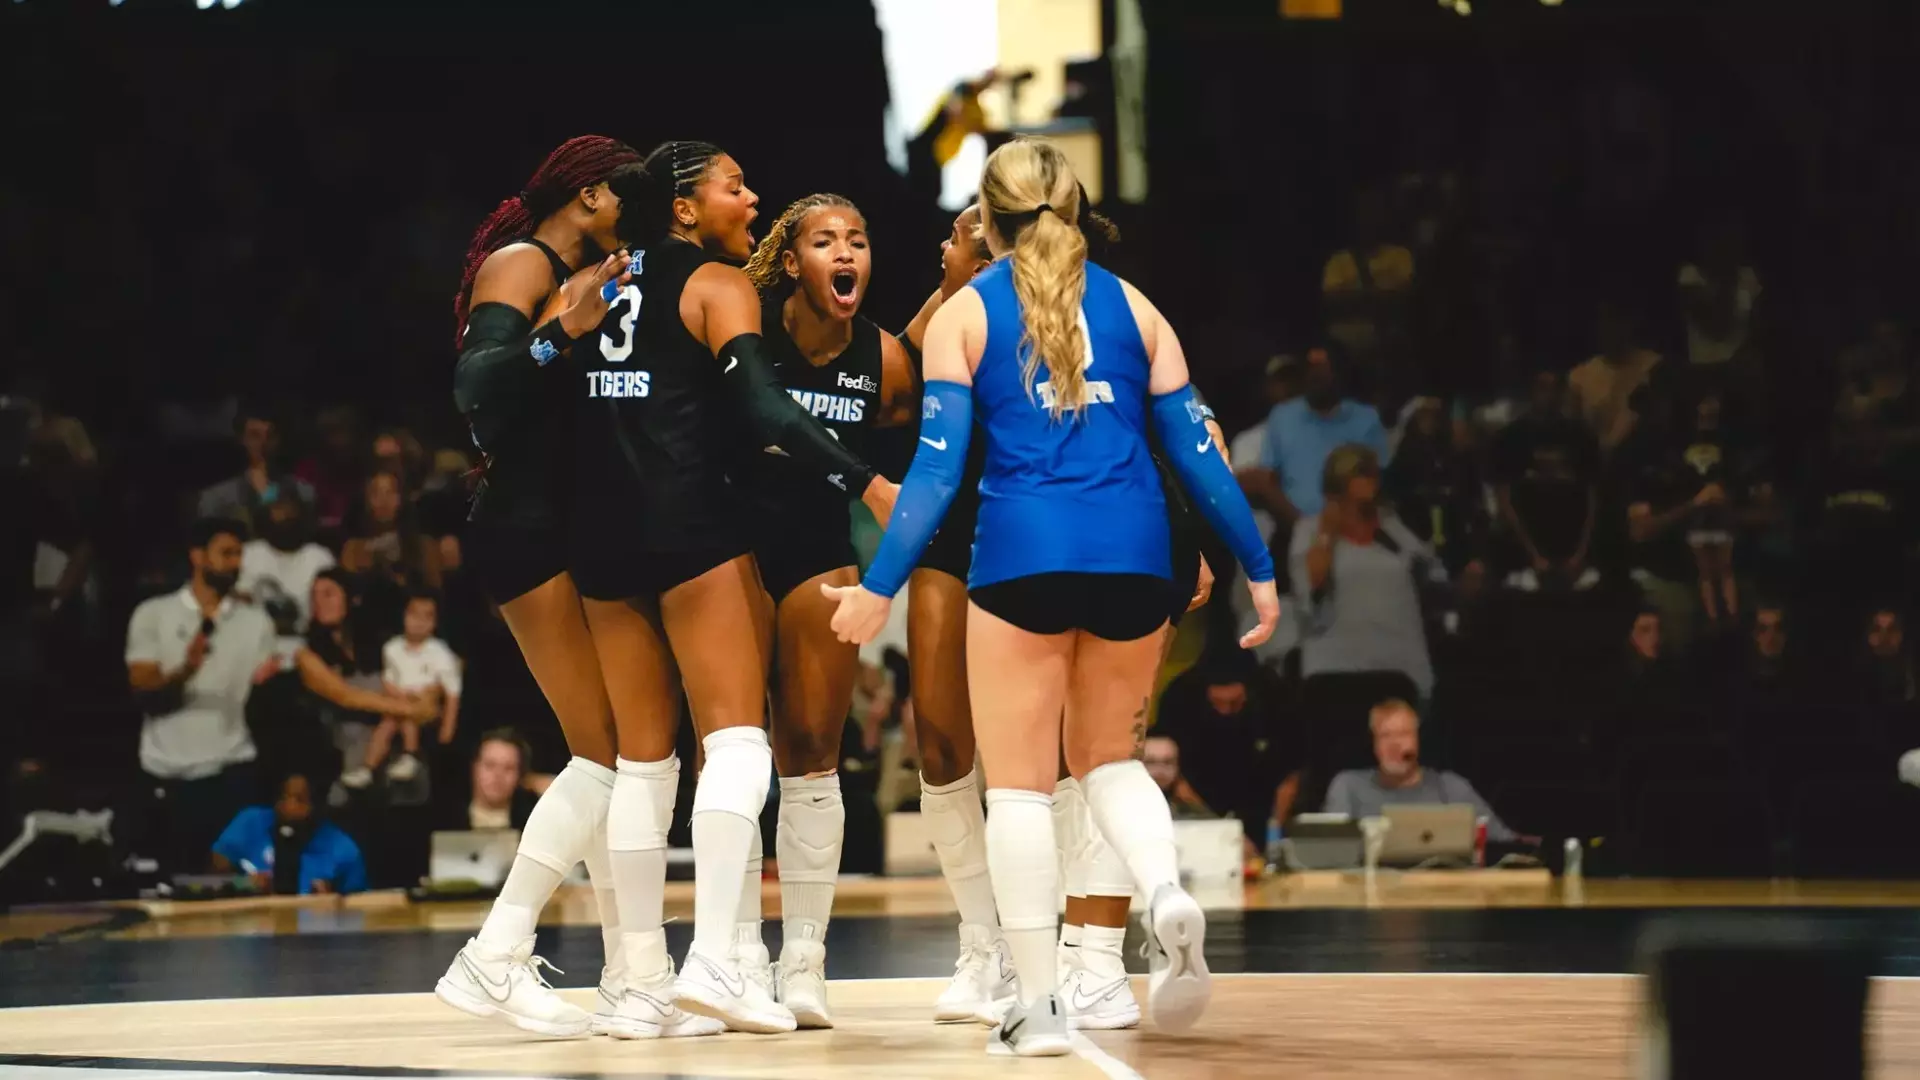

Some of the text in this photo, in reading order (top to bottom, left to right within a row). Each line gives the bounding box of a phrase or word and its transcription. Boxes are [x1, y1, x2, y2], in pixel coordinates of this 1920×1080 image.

[599, 285, 643, 362] 3
[586, 370, 650, 398] TGERS
[837, 371, 877, 393] FedEx
[785, 388, 866, 422] MPHIS
